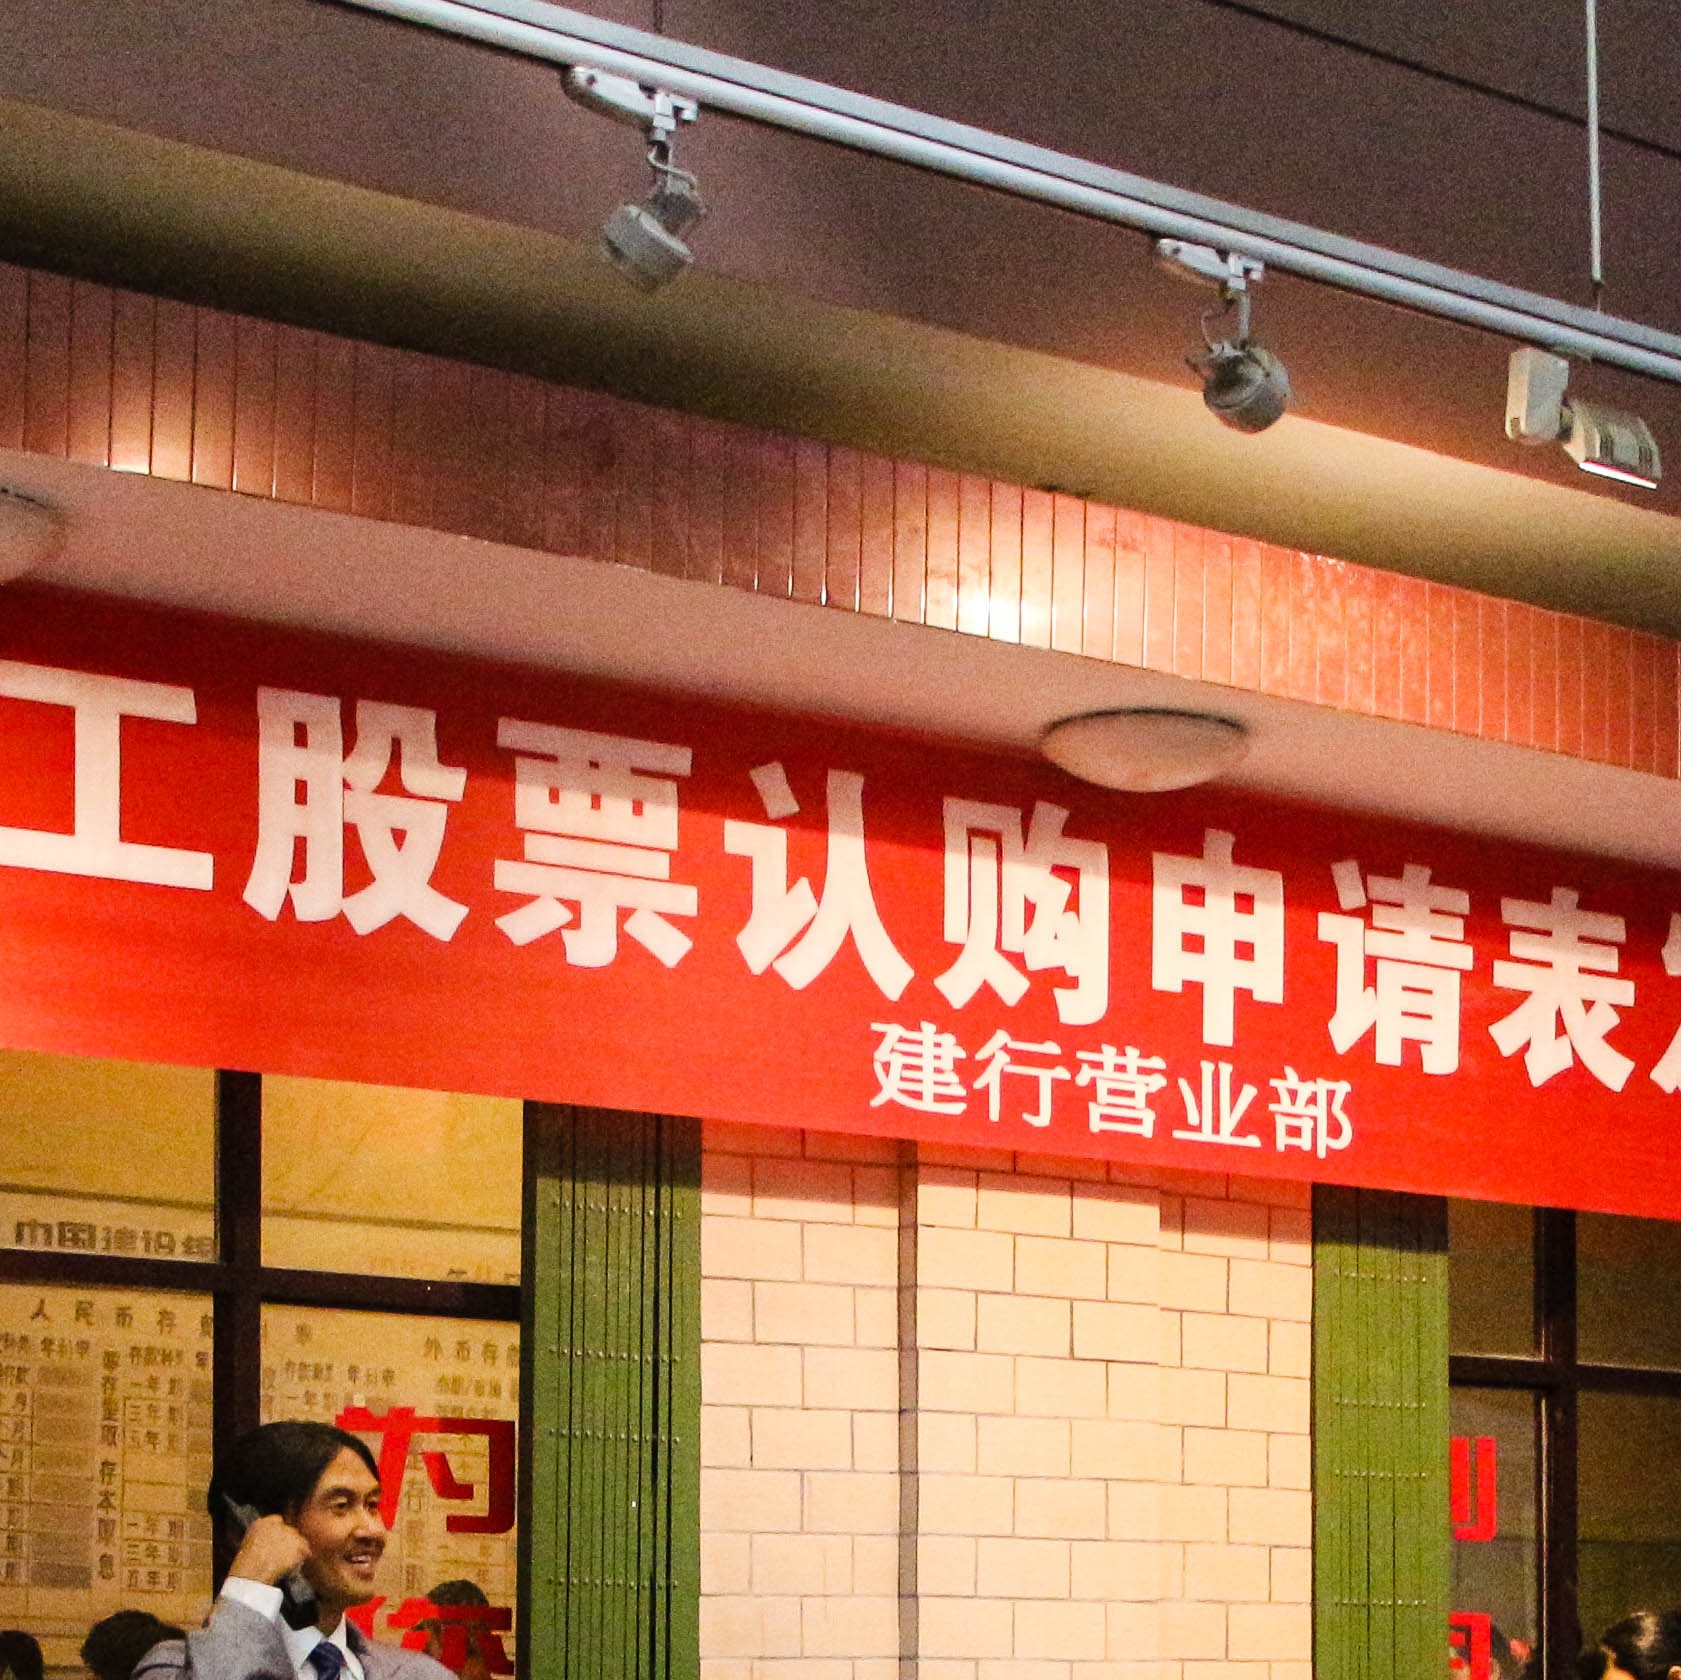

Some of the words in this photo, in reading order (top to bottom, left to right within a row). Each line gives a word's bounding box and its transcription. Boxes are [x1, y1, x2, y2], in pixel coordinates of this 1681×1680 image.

[869, 1020, 1353, 1160] 建行营业部
